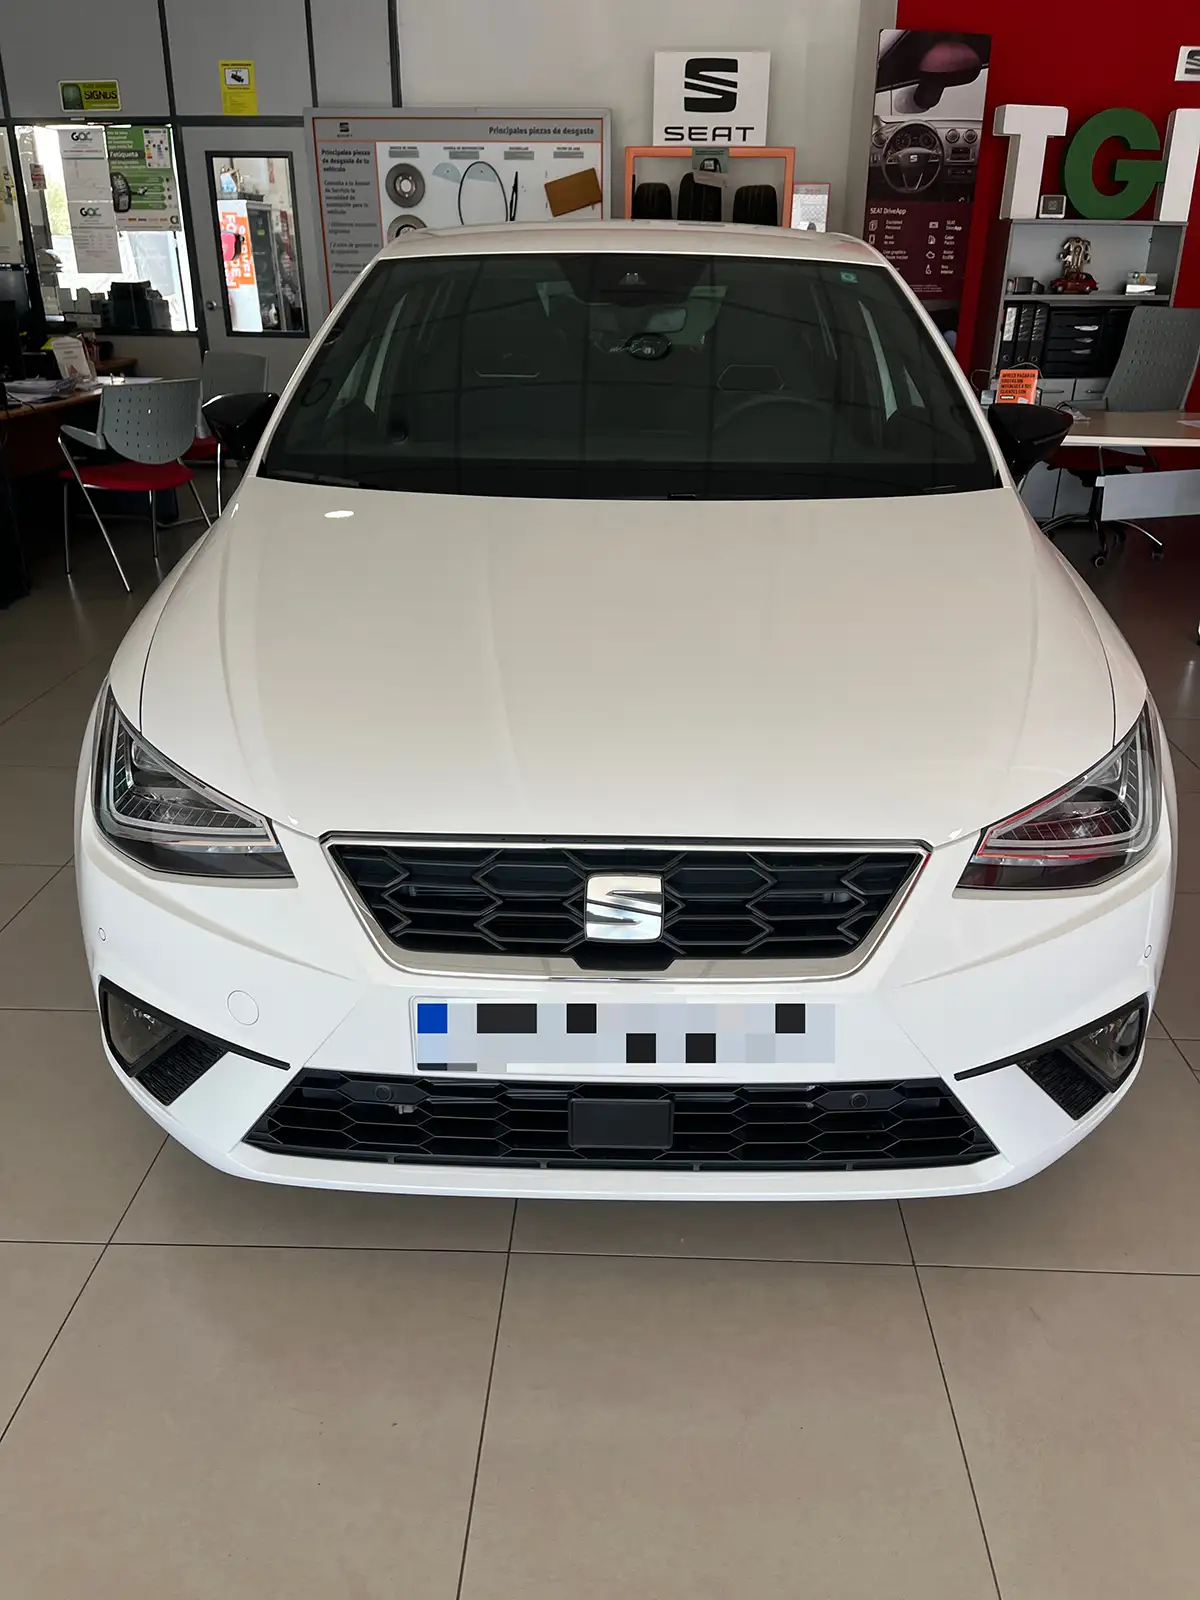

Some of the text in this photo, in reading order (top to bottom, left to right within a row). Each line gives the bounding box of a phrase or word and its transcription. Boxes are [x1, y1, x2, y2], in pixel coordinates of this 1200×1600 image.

[84, 91, 117, 100] SIGNUS
[489, 126, 594, 136] Principales piezas de desgaste
[664, 126, 755, 141] SEAT
[993, 104, 1200, 222] TGI
[870, 207, 907, 215] SEAT DriveApp
